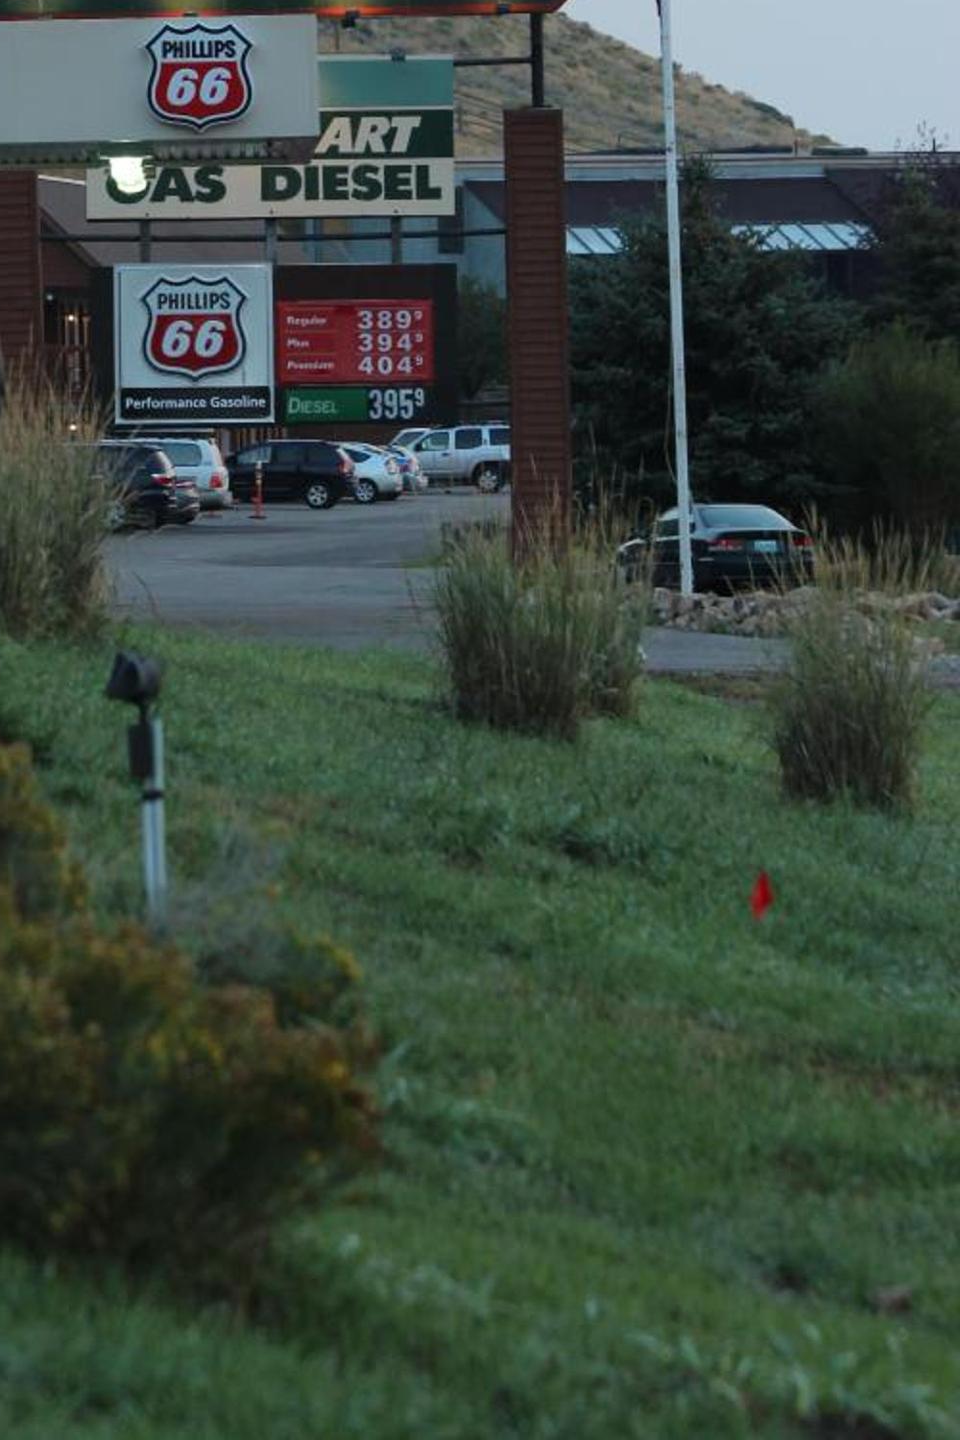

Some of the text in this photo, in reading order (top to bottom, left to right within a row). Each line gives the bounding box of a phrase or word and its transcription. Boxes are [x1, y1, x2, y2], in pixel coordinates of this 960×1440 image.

[161, 39, 237, 59] PHILLIPS
[166, 68, 233, 106] 66
[260, 164, 443, 201] DIESEL
[156, 292, 231, 310] PHILLIPS
[286, 315, 327, 327] Regular
[161, 320, 226, 358] 66
[125, 395, 266, 409] Performance Gasoline
